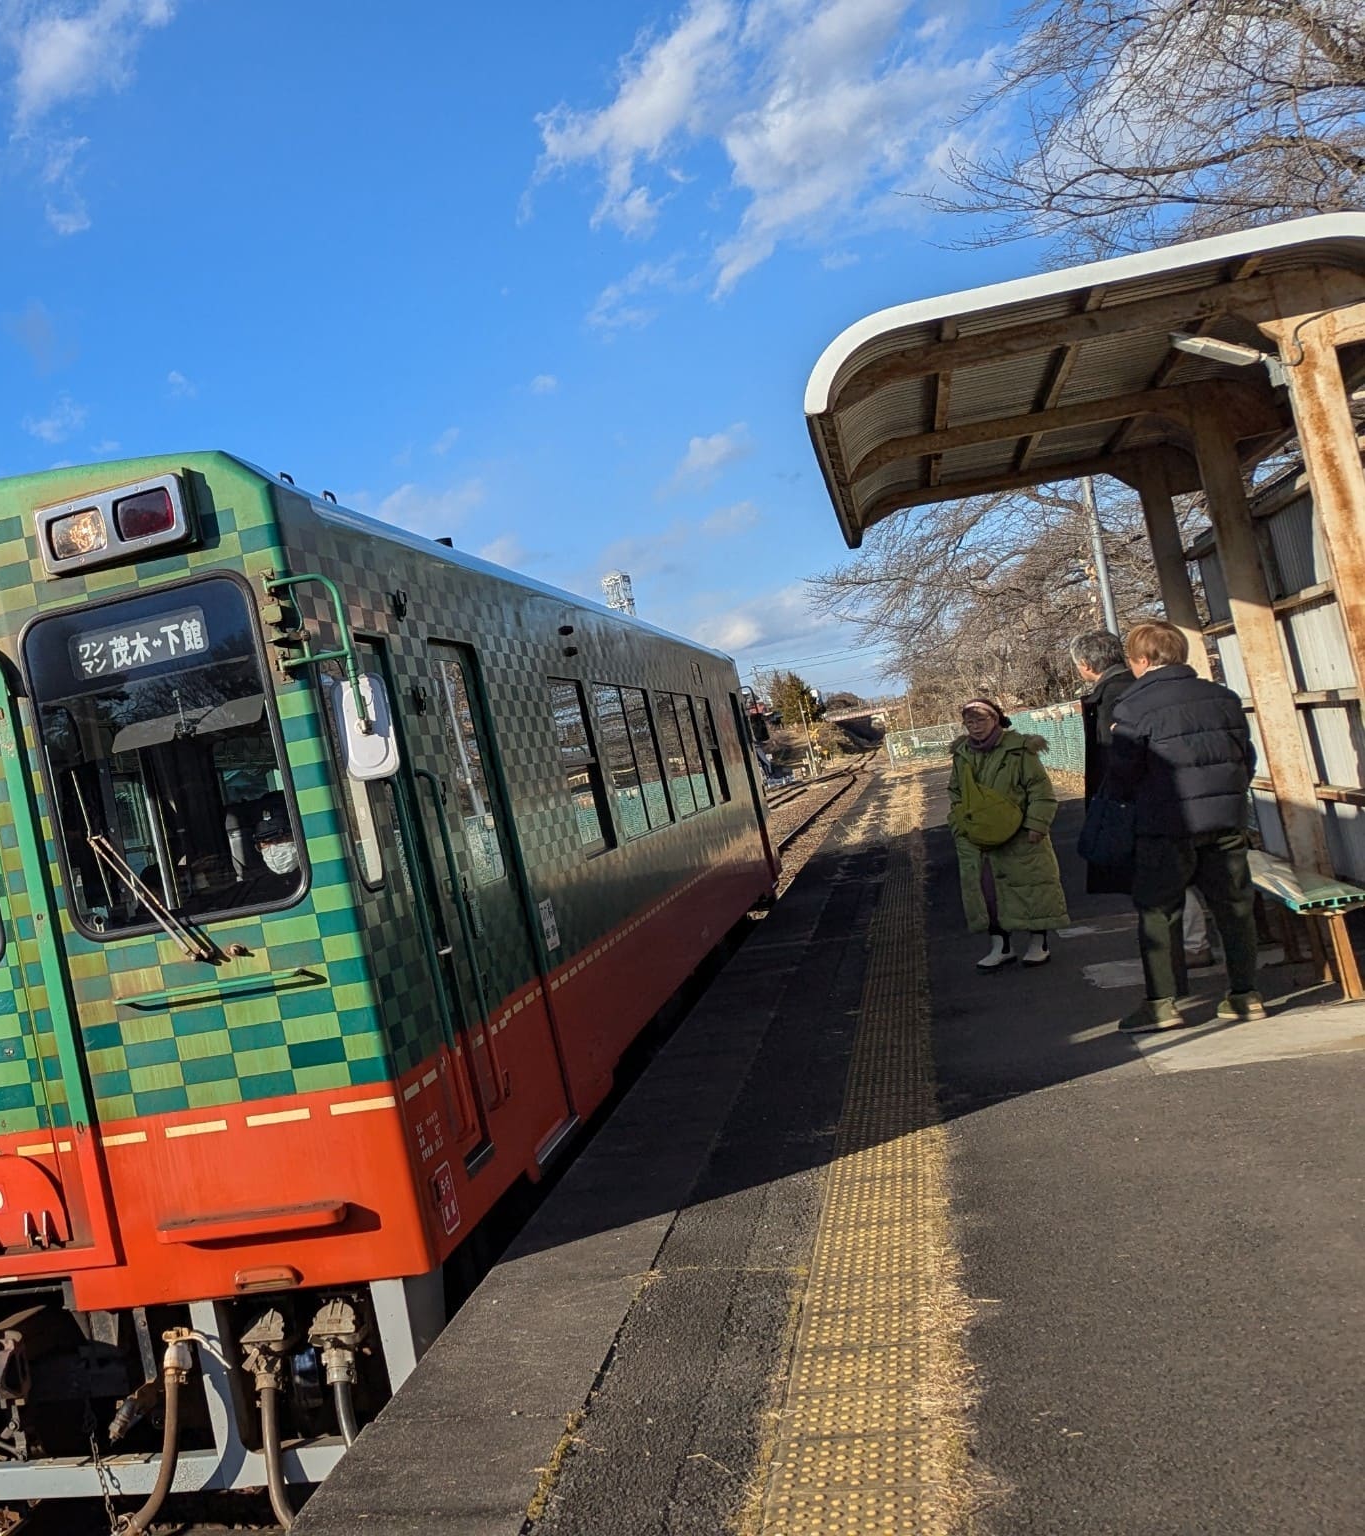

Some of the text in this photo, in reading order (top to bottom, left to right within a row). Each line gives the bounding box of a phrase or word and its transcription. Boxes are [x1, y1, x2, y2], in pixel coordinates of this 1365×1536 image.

[78, 642, 104, 659] ワン
[108, 618, 205, 669] 茂木 下館
[81, 658, 107, 674] マン
